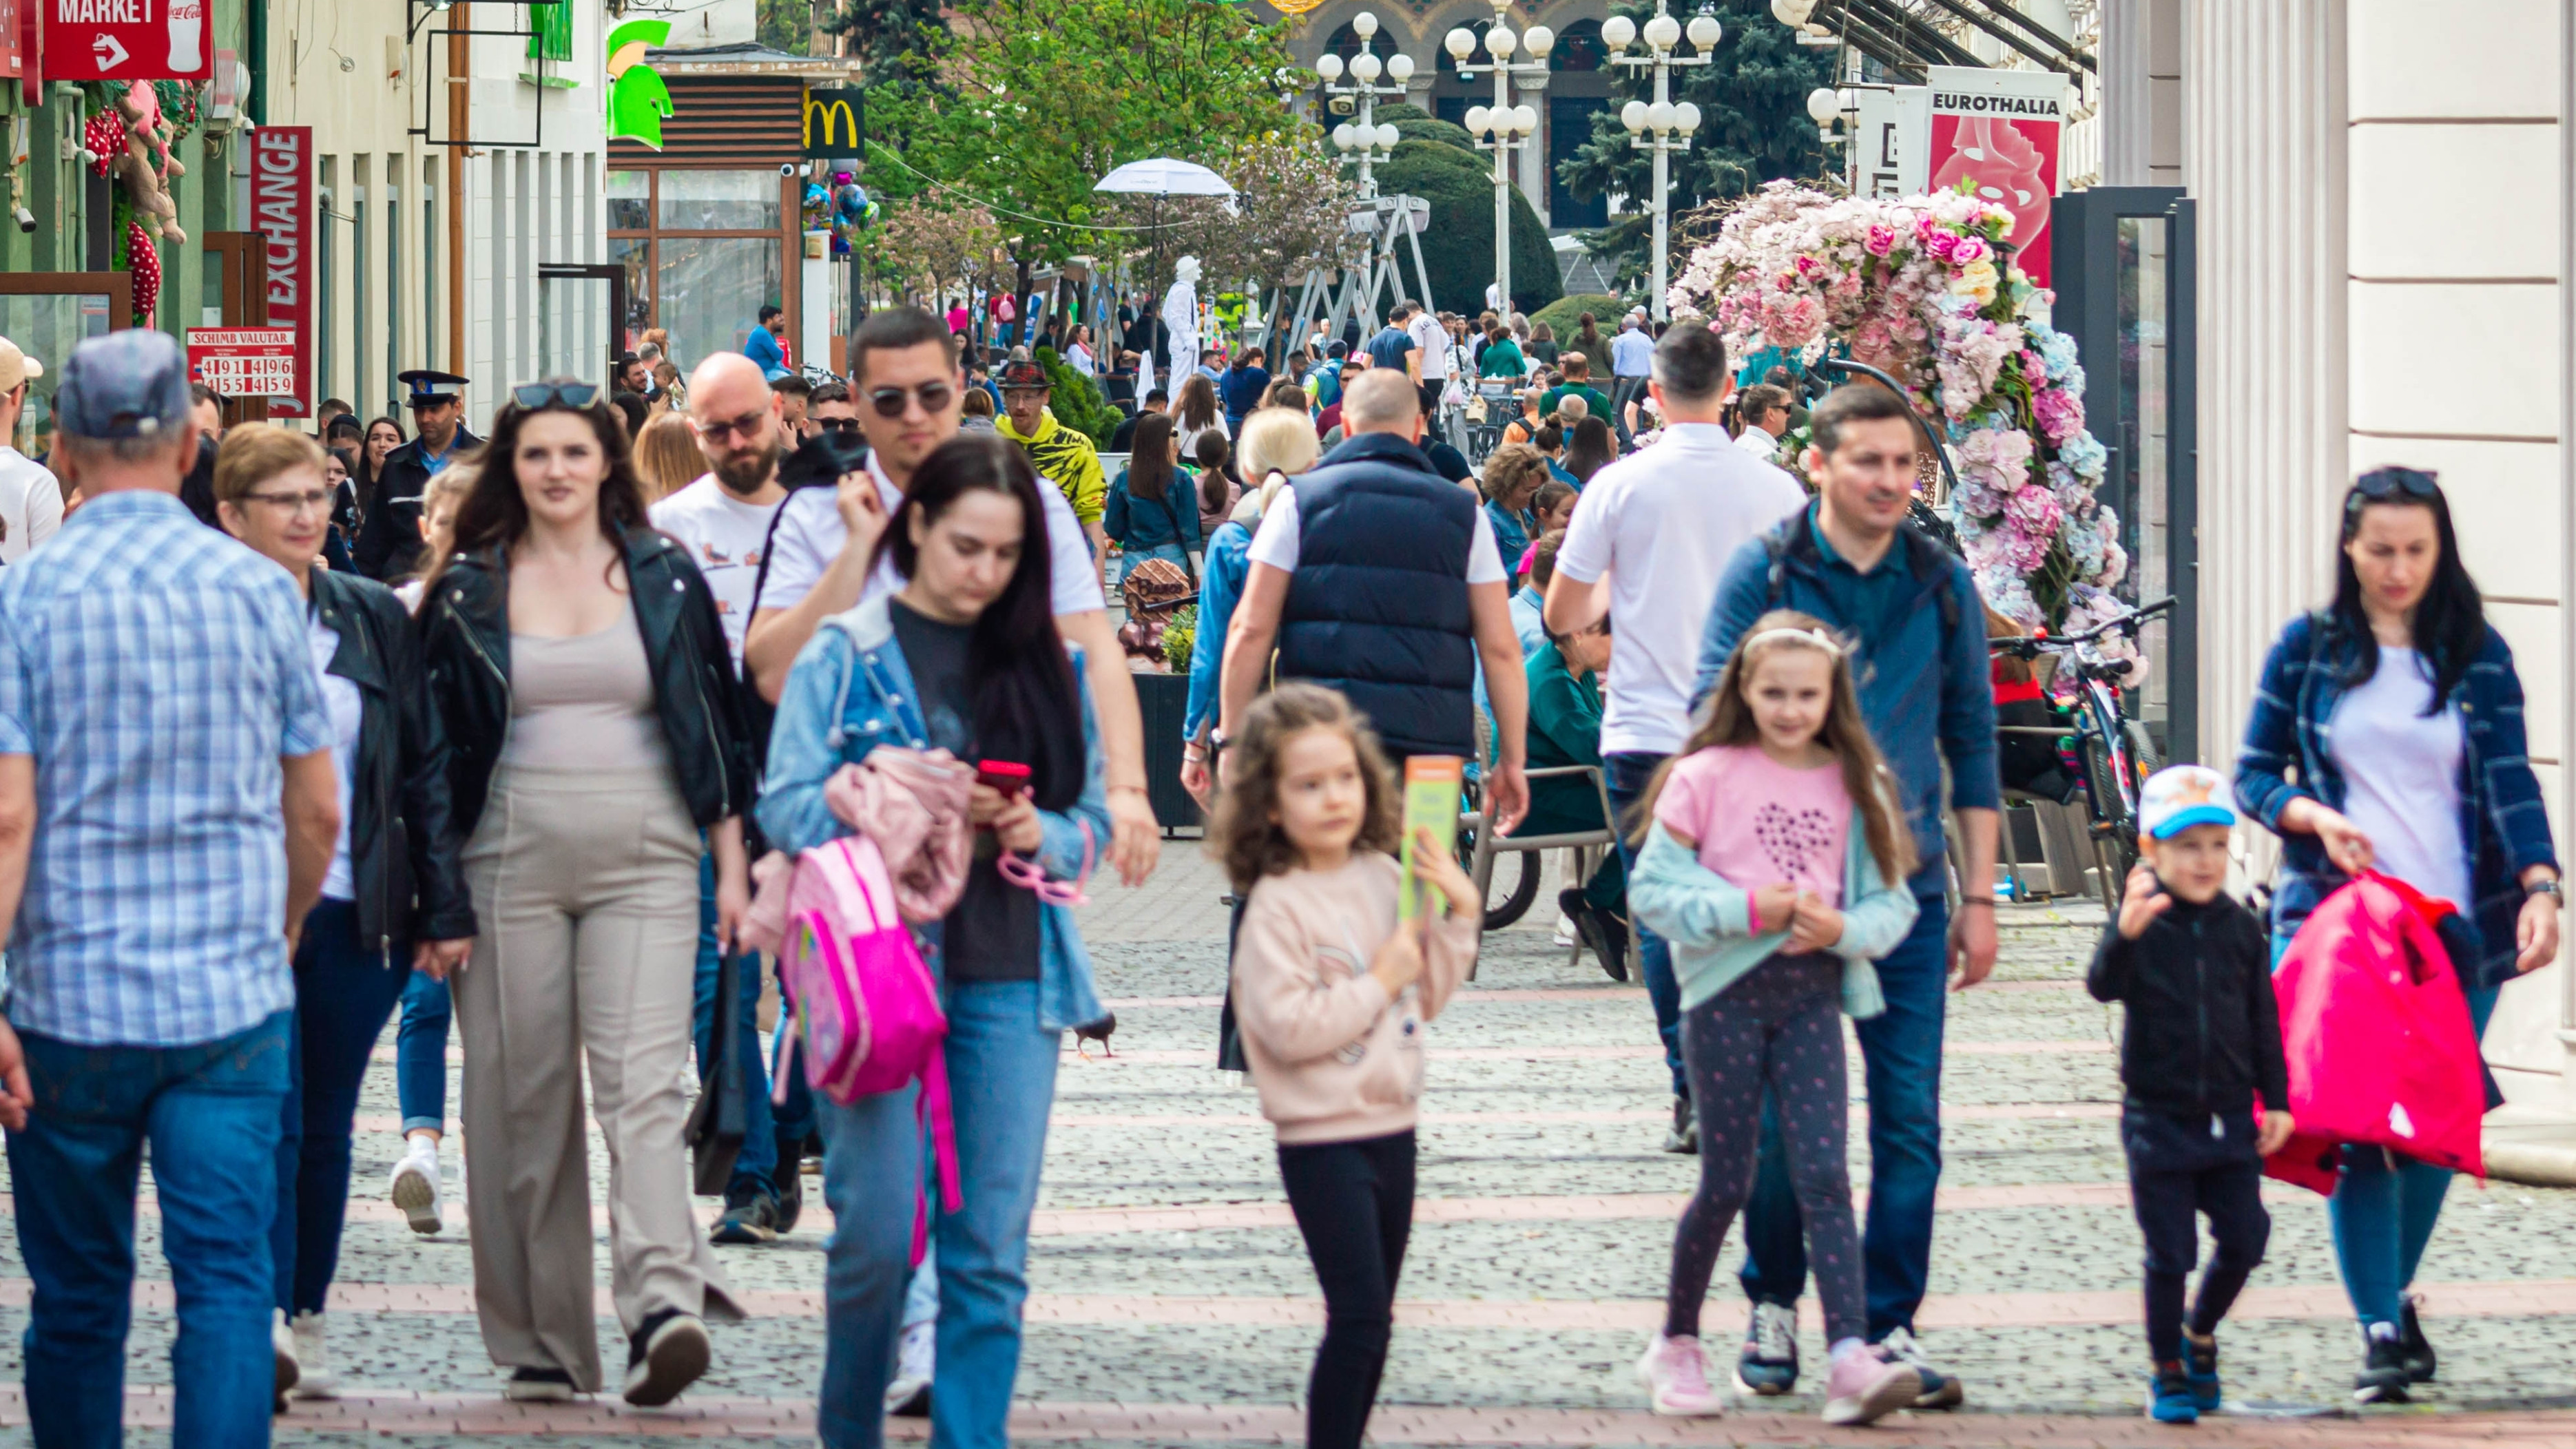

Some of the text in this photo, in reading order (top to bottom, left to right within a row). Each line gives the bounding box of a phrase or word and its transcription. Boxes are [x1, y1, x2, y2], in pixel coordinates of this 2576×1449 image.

[1933, 94, 2059, 115] EUROTHALIA
[260, 132, 298, 305] EXCHANGE
[194, 333, 287, 344] SCHIMB VALUTAR
